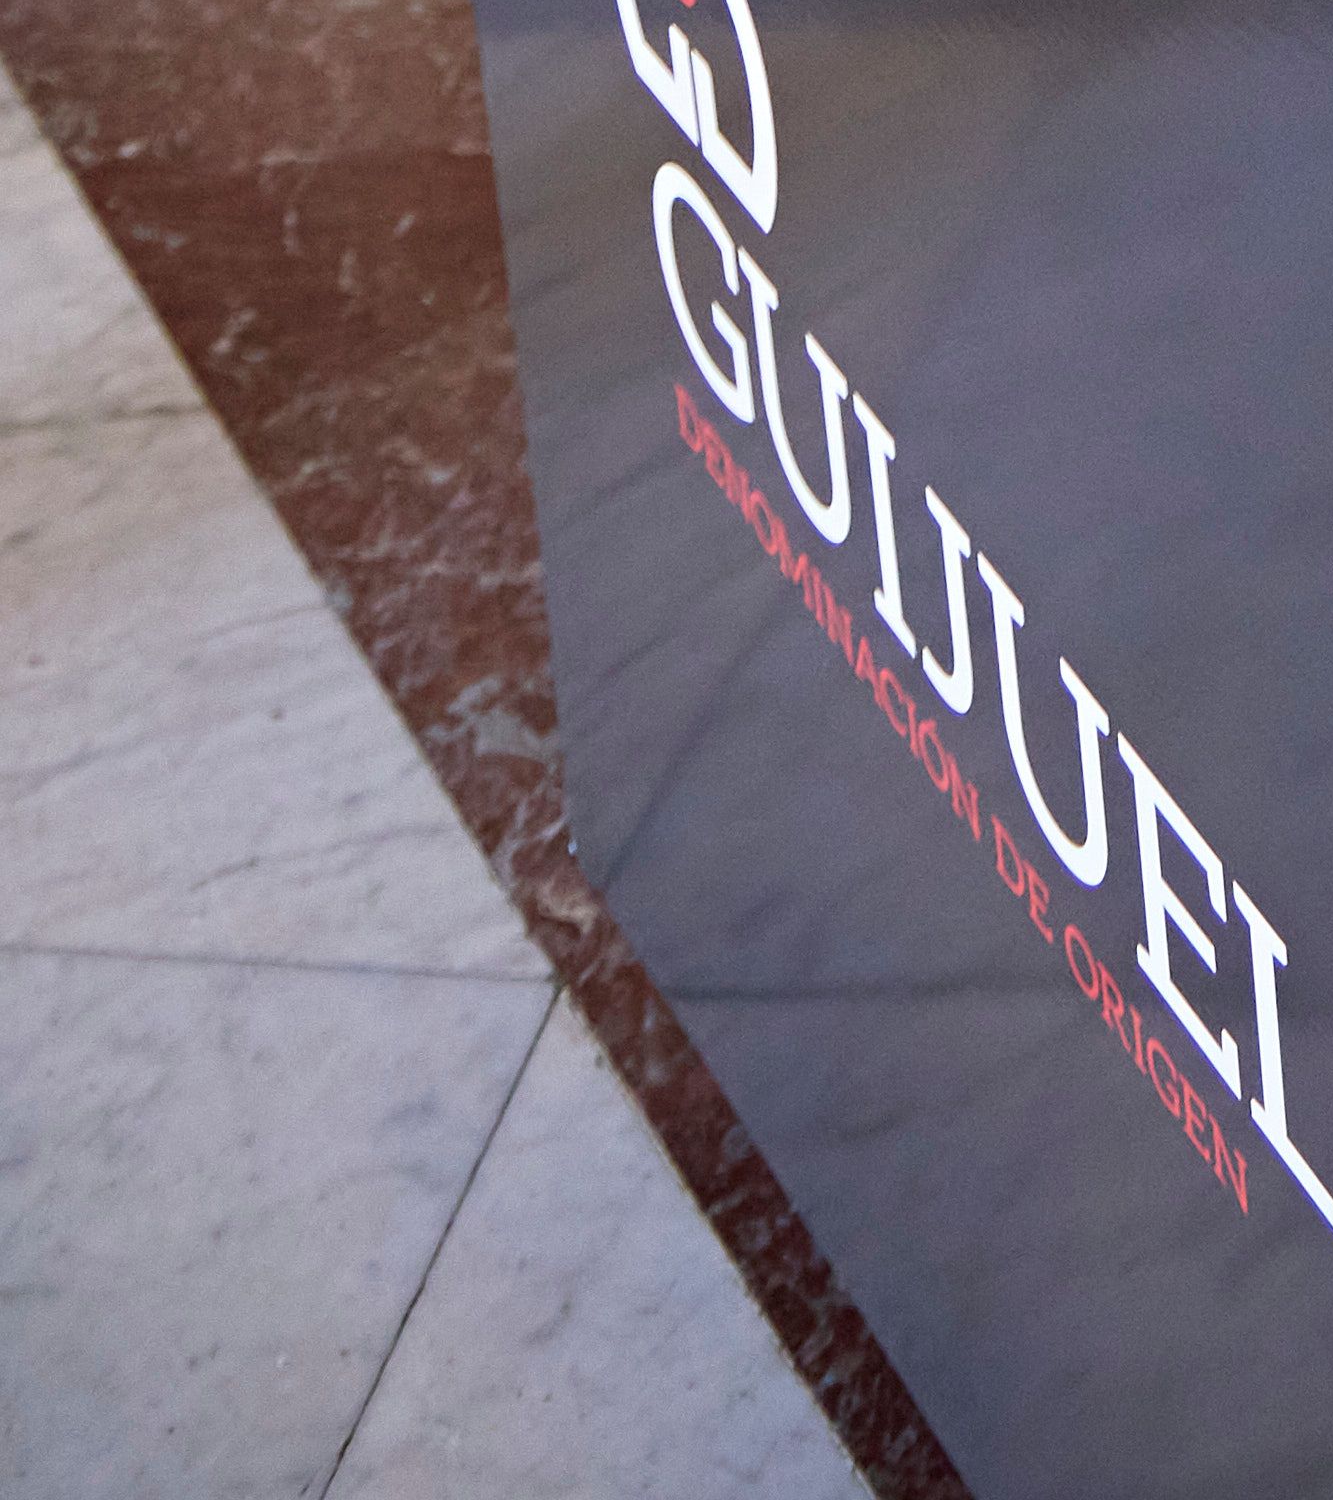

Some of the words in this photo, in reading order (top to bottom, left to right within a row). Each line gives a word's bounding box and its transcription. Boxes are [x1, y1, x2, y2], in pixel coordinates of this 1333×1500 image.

[675, 385, 981, 841] DENOMINACIÓN
[991, 815, 1054, 943] DE
[1063, 924, 1249, 1213] ORIGEN
